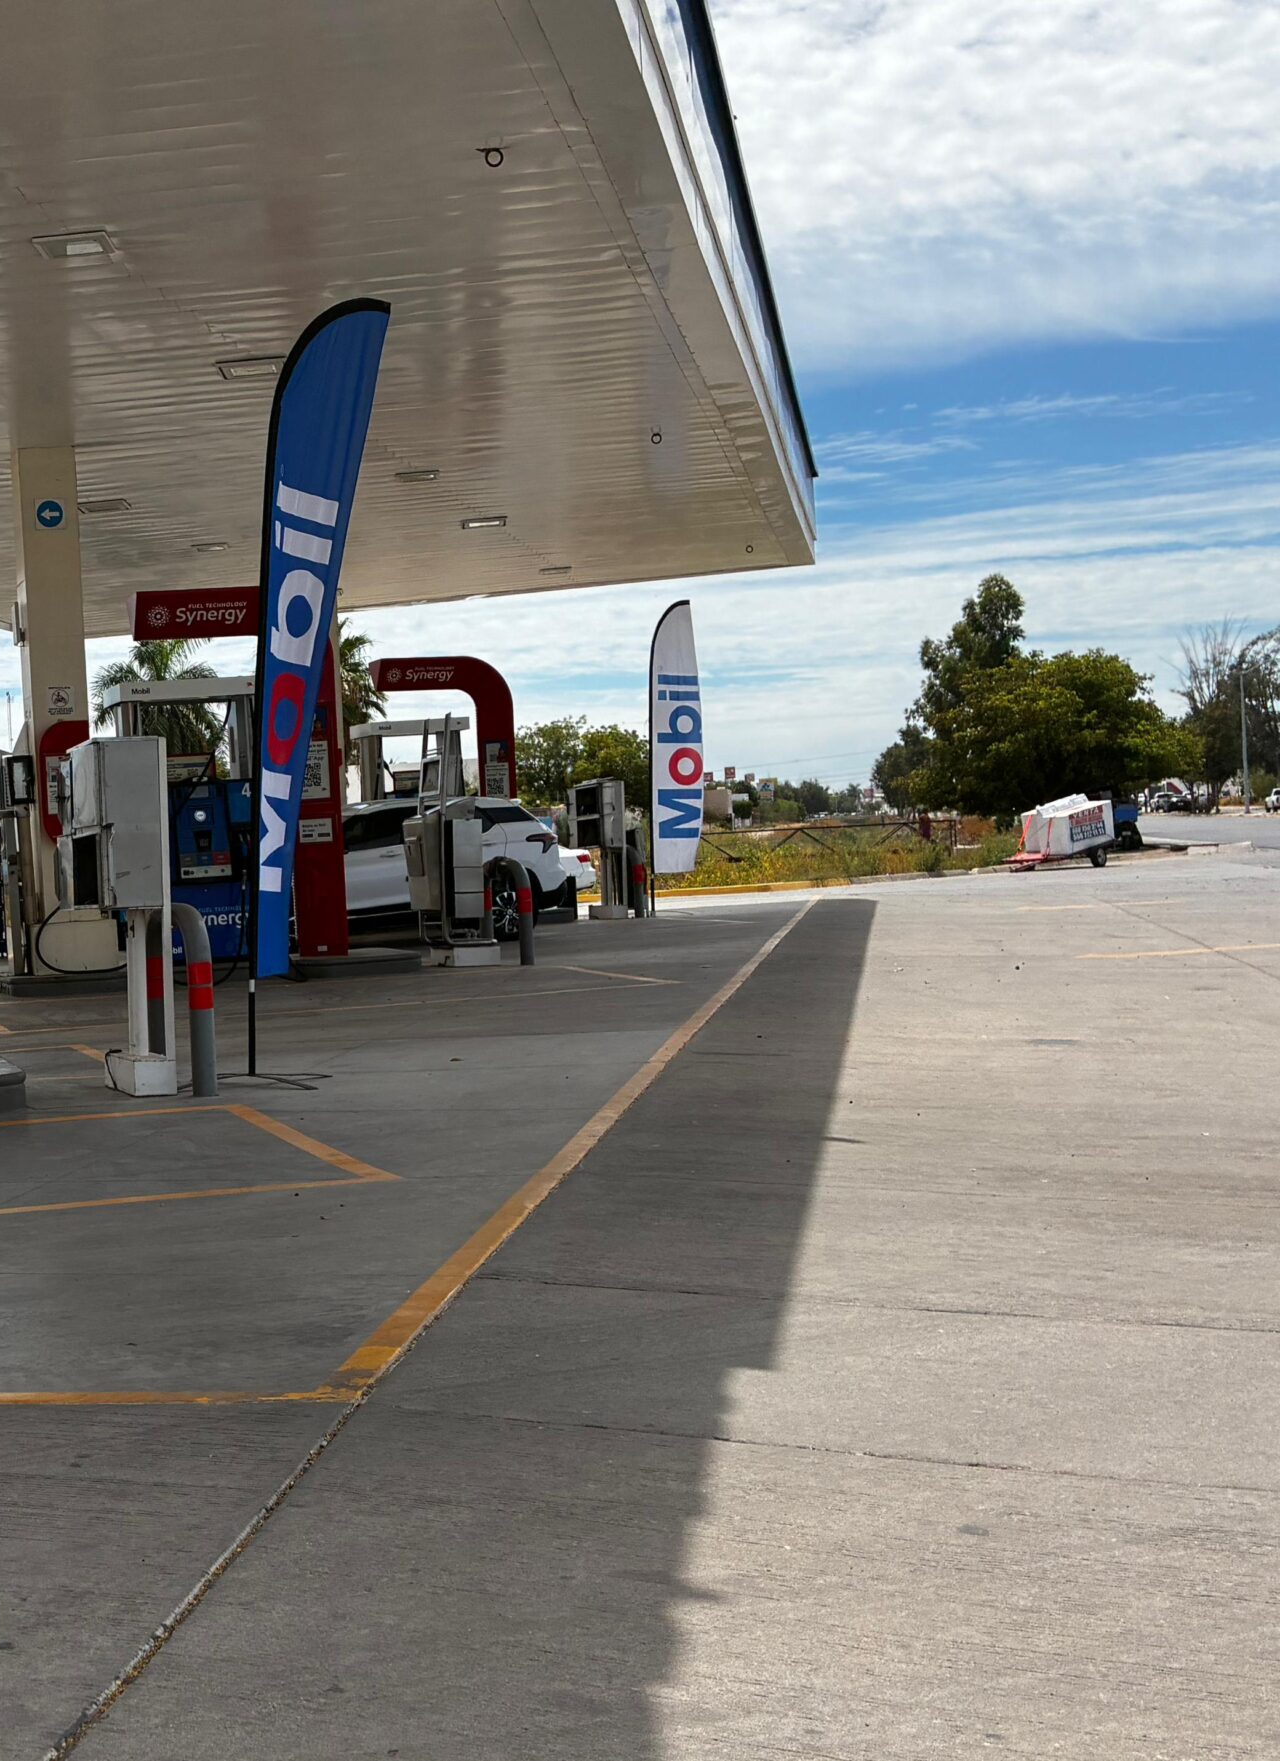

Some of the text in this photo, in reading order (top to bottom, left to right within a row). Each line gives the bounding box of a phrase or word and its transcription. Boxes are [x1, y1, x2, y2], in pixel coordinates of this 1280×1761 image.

[175, 607, 247, 626] Synergy
[405, 669, 455, 683] Synergy
[131, 687, 151, 695] Mobil
[259, 480, 339, 893] Mobil
[657, 674, 703, 840] Mobil
[241, 783, 252, 798] 4
[1072, 806, 1100, 818] VENTA
[172, 946, 183, 955] bil
